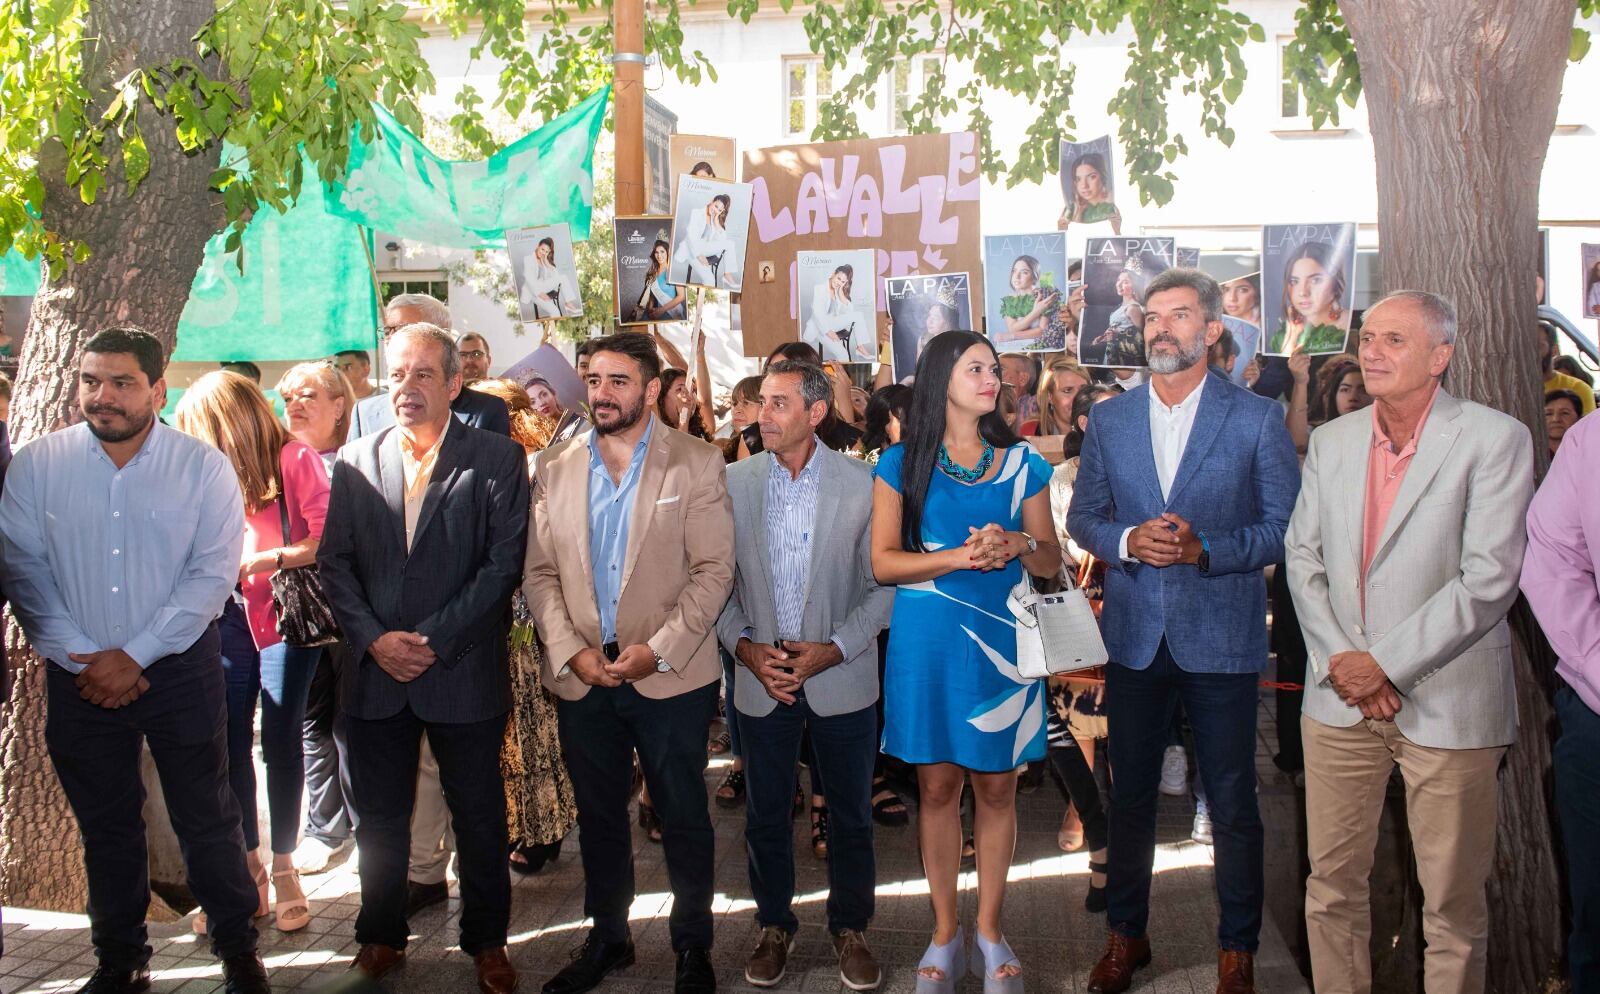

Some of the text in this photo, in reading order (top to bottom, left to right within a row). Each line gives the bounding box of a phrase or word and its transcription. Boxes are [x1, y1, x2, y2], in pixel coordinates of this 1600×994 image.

[750, 132, 980, 244] LAVALLE
[989, 234, 1065, 256] LA PAZ
[1088, 239, 1172, 257] LA PAZ
[1266, 225, 1350, 249] LA PA
[889, 279, 917, 297] LA
[923, 276, 967, 296] PAZ
